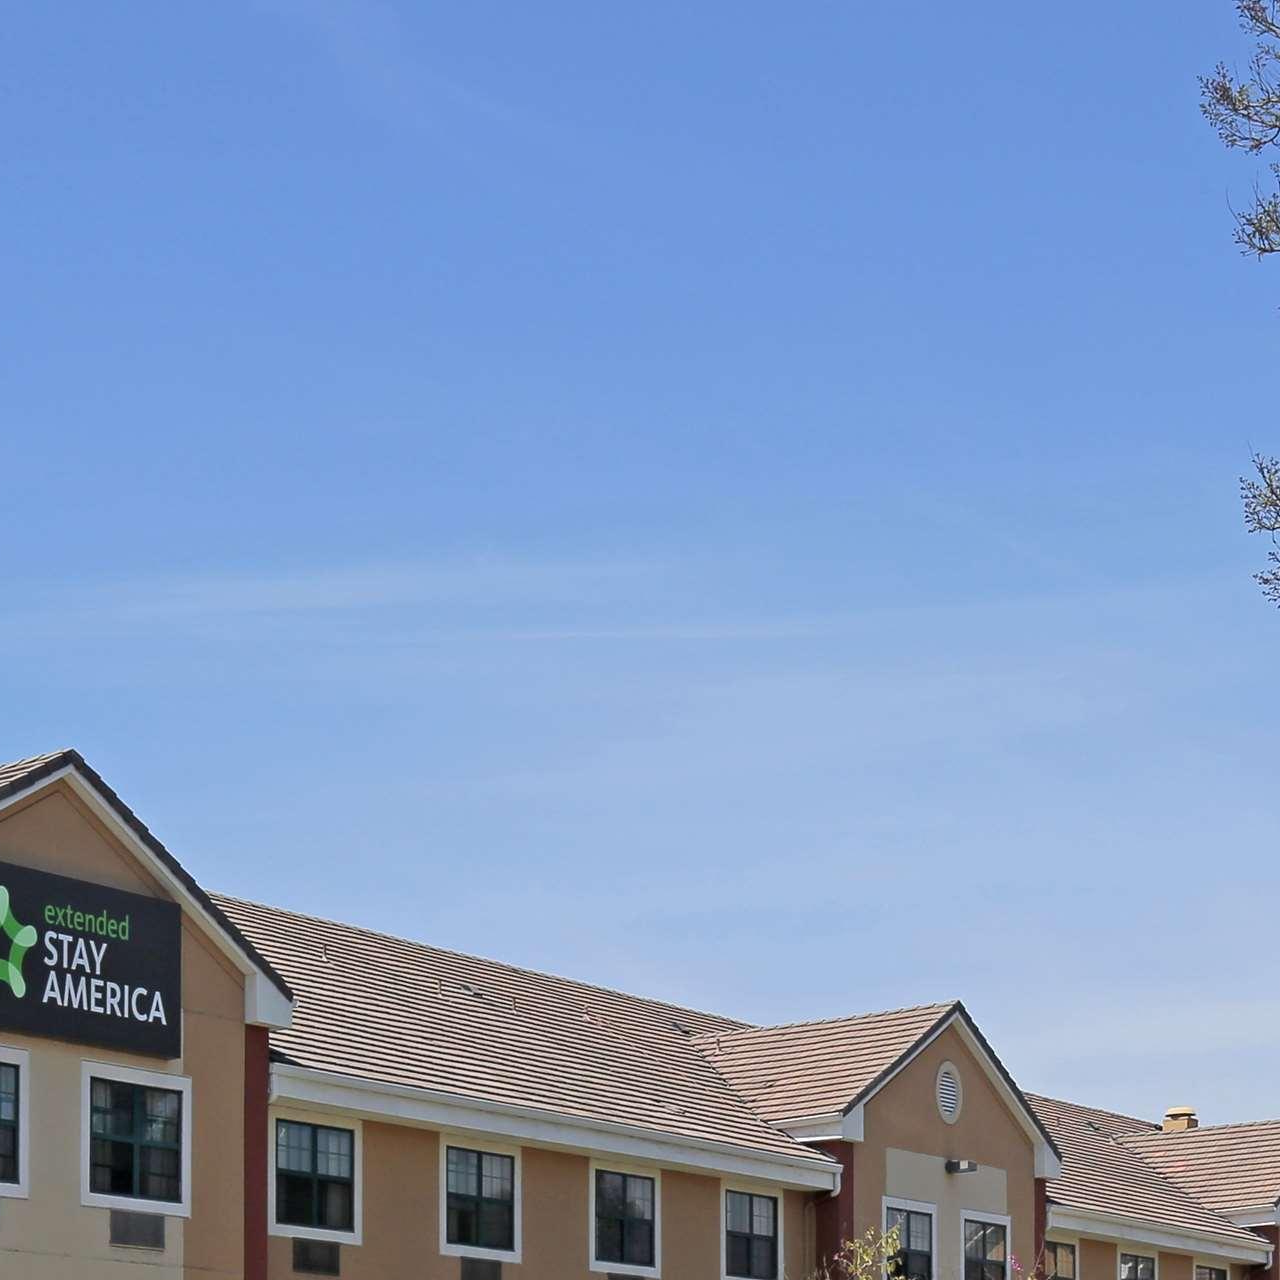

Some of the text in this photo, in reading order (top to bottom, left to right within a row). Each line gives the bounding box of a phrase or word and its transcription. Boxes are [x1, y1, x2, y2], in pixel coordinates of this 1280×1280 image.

[44, 904, 129, 940] extended
[43, 931, 107, 975] STAY
[42, 970, 167, 1025] AMERICA
